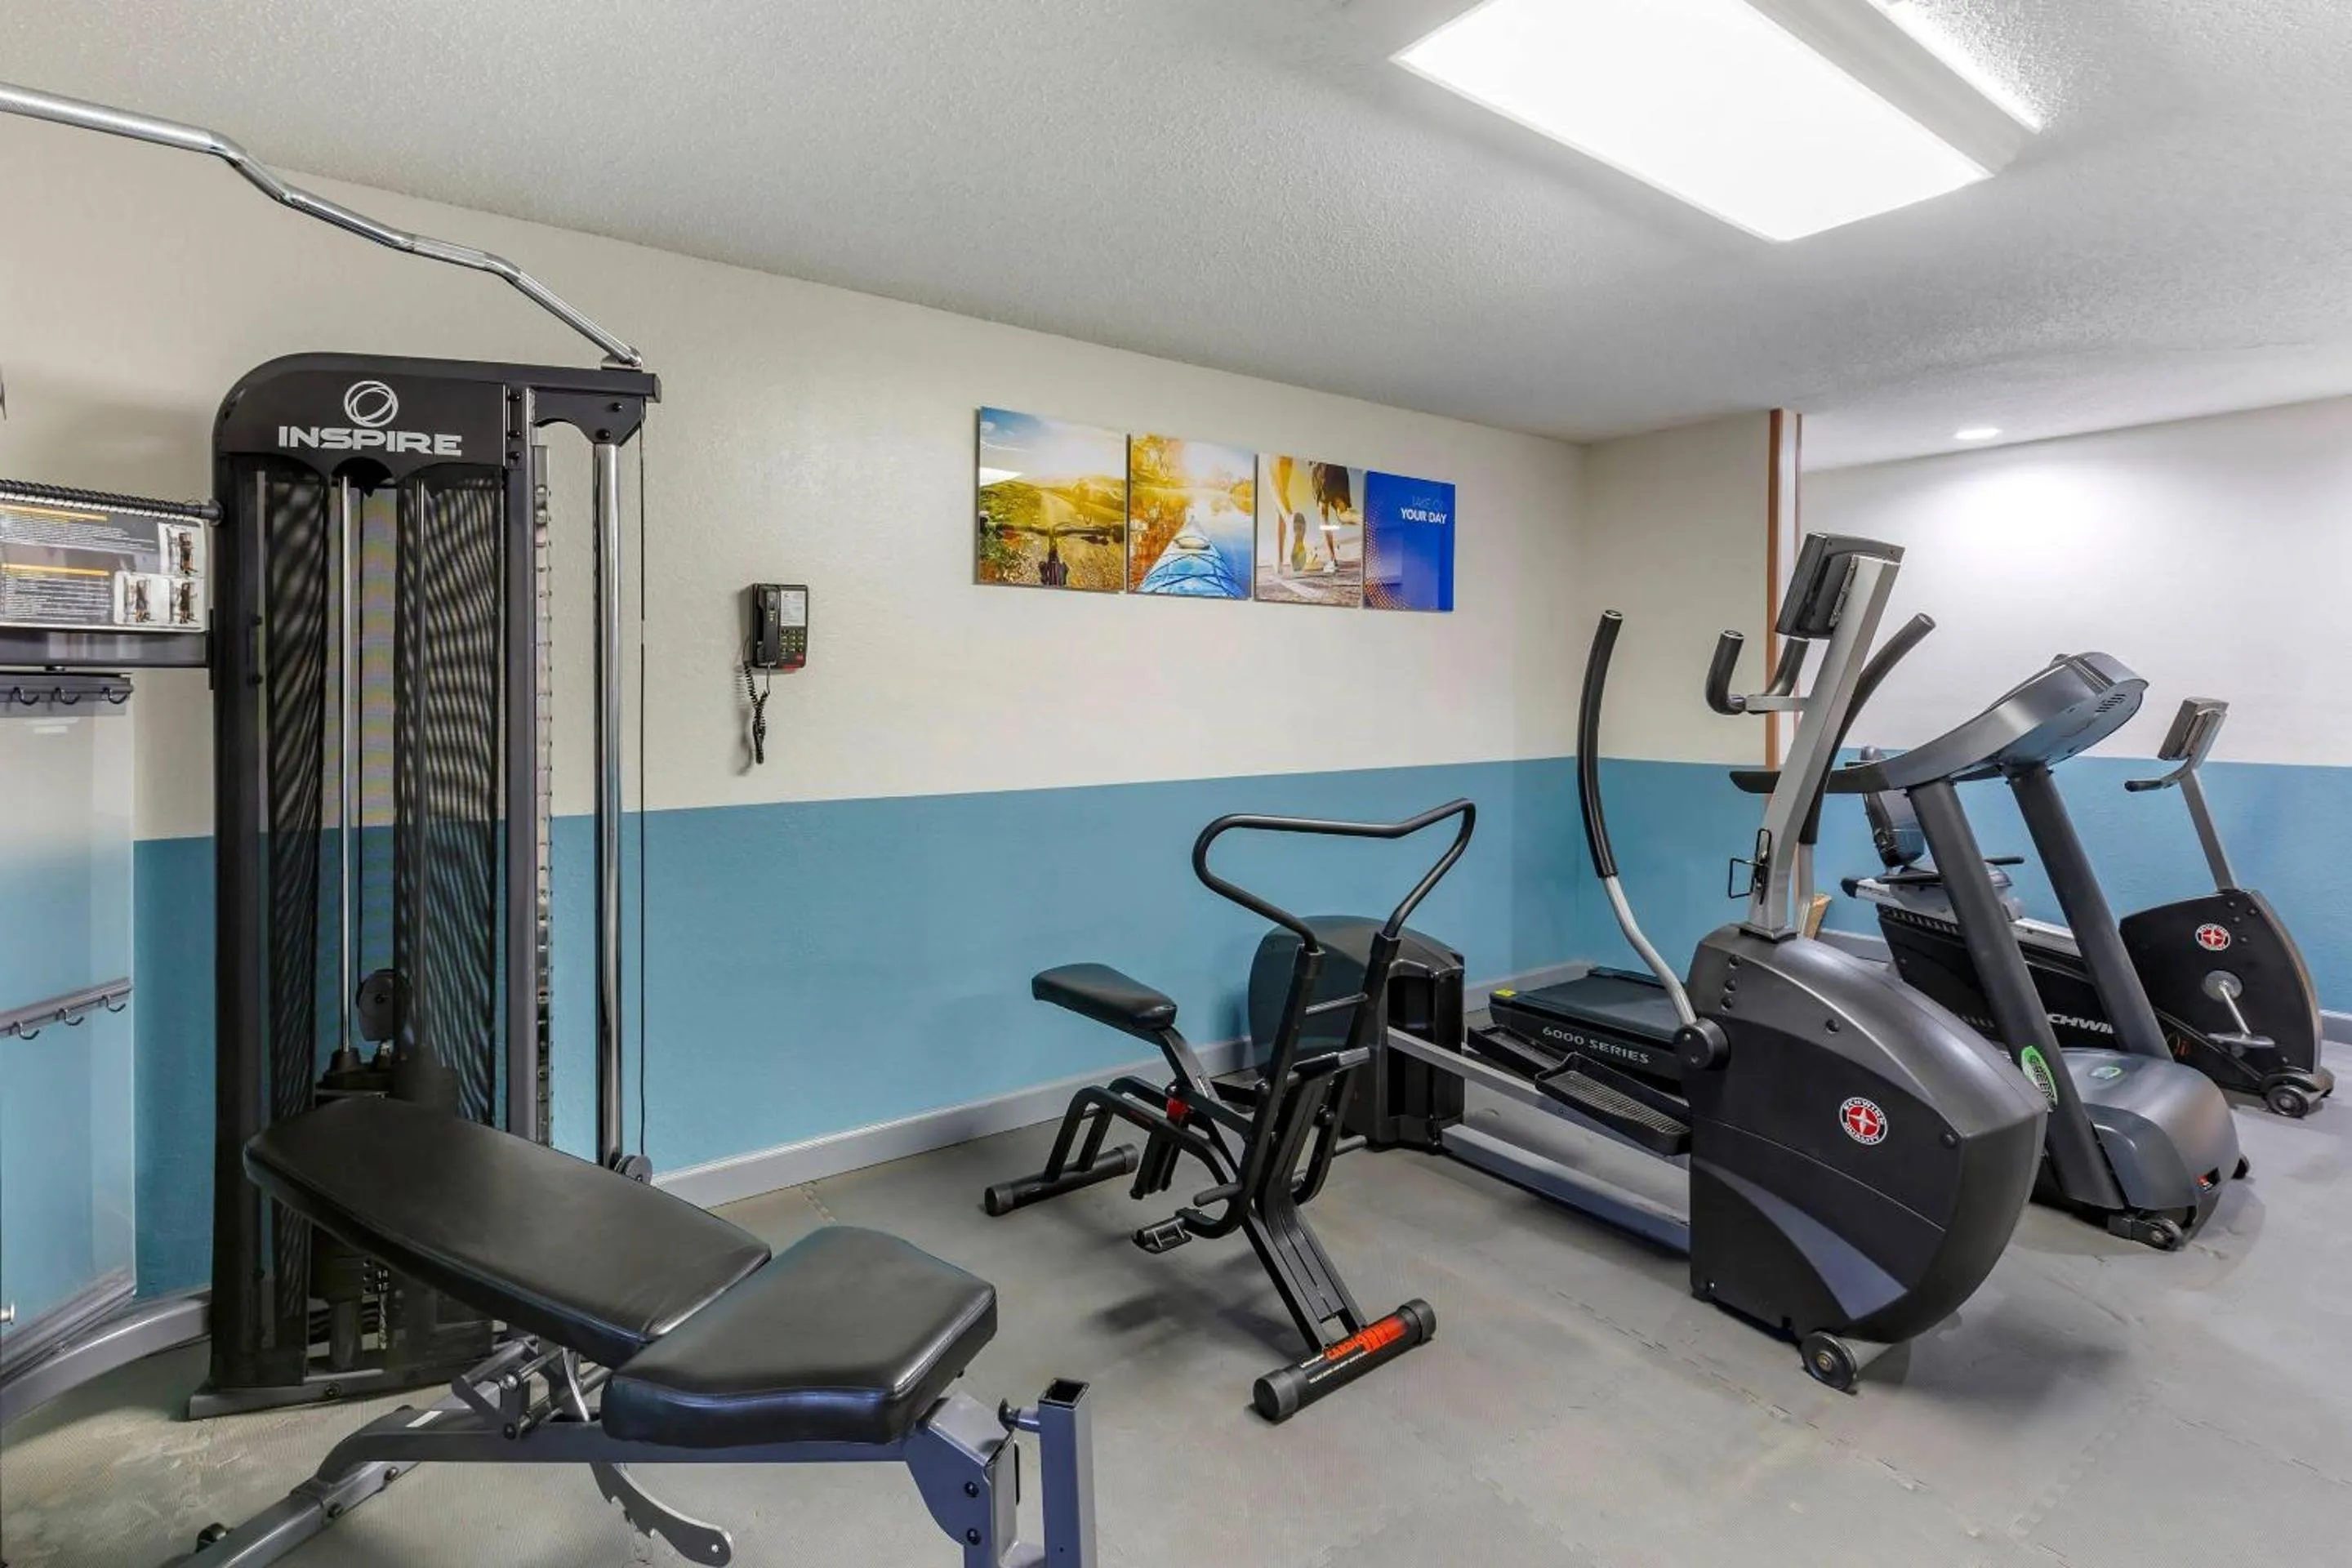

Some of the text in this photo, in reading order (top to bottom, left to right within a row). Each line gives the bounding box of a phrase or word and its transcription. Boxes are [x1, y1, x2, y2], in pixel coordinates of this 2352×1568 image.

[278, 425, 462, 457] INSPIRE
[1400, 506, 1447, 524] YOUR DAY
[1543, 1027, 1649, 1064] 6000 SERIES
